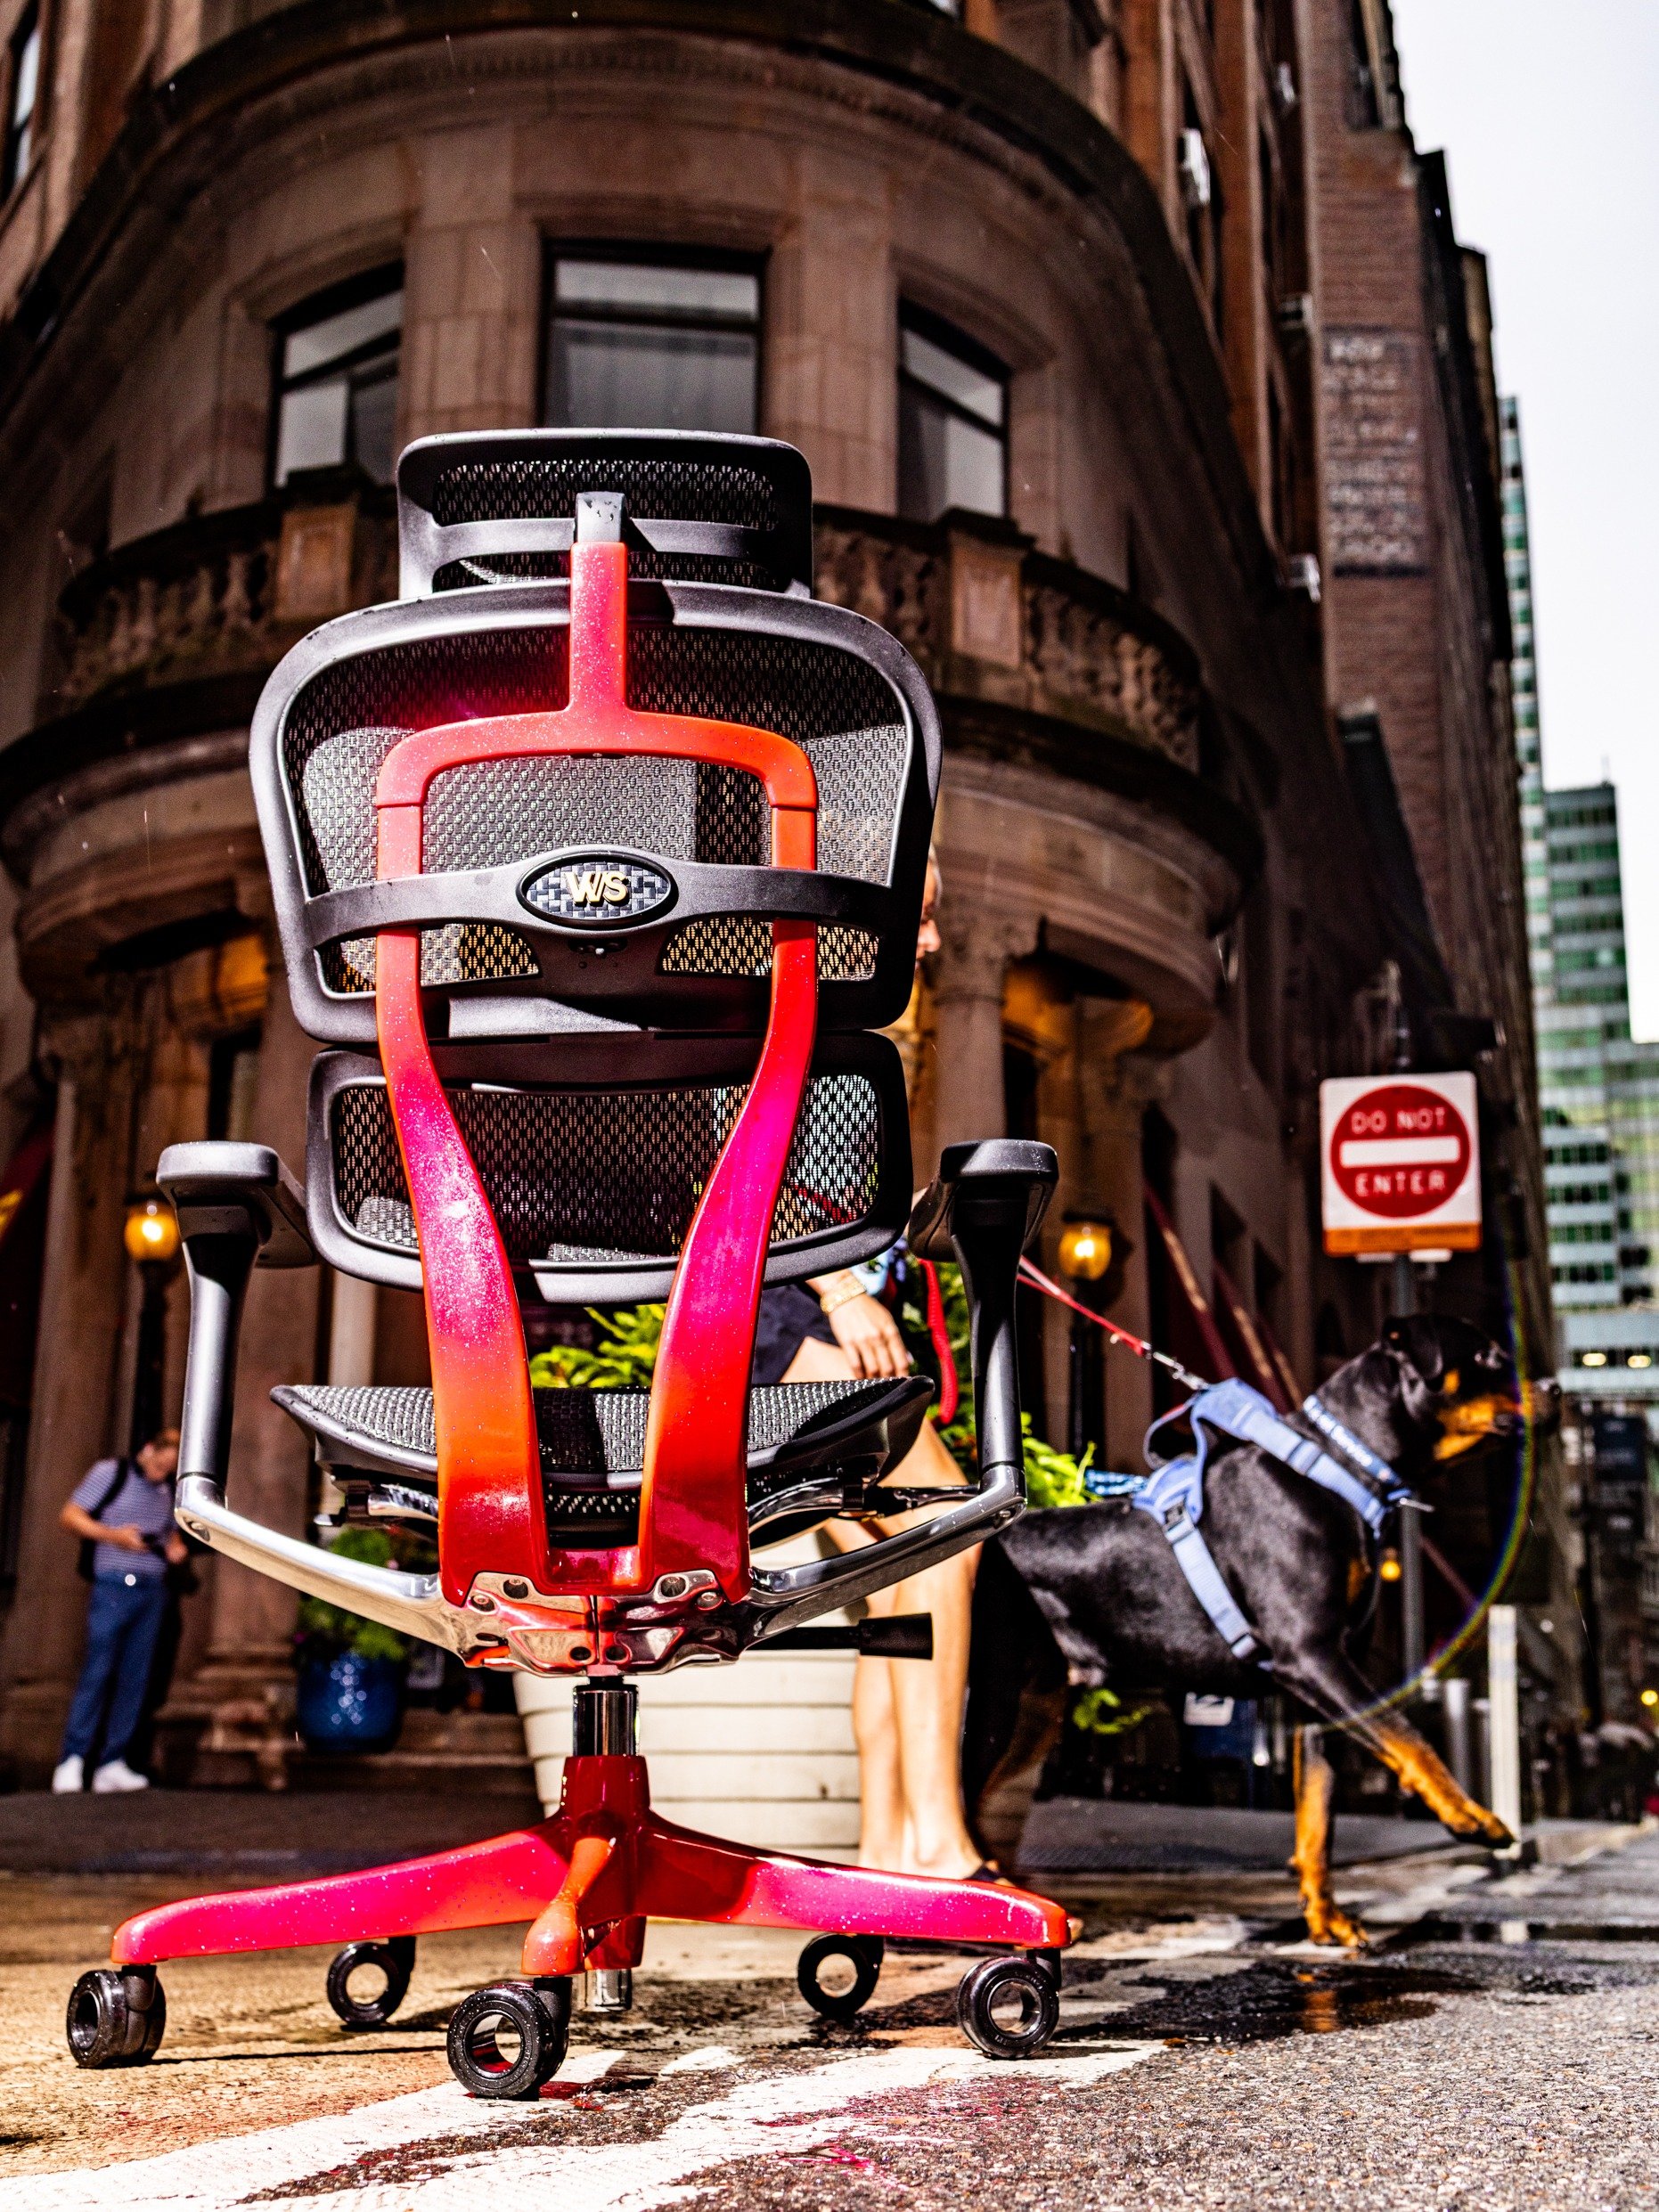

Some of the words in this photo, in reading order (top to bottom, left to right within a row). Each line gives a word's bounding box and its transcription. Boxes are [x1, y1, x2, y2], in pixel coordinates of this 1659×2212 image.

[1351, 1109, 1387, 1134] DO
[1396, 1106, 1446, 1130] NOT
[1354, 1170, 1446, 1197] ENTER
